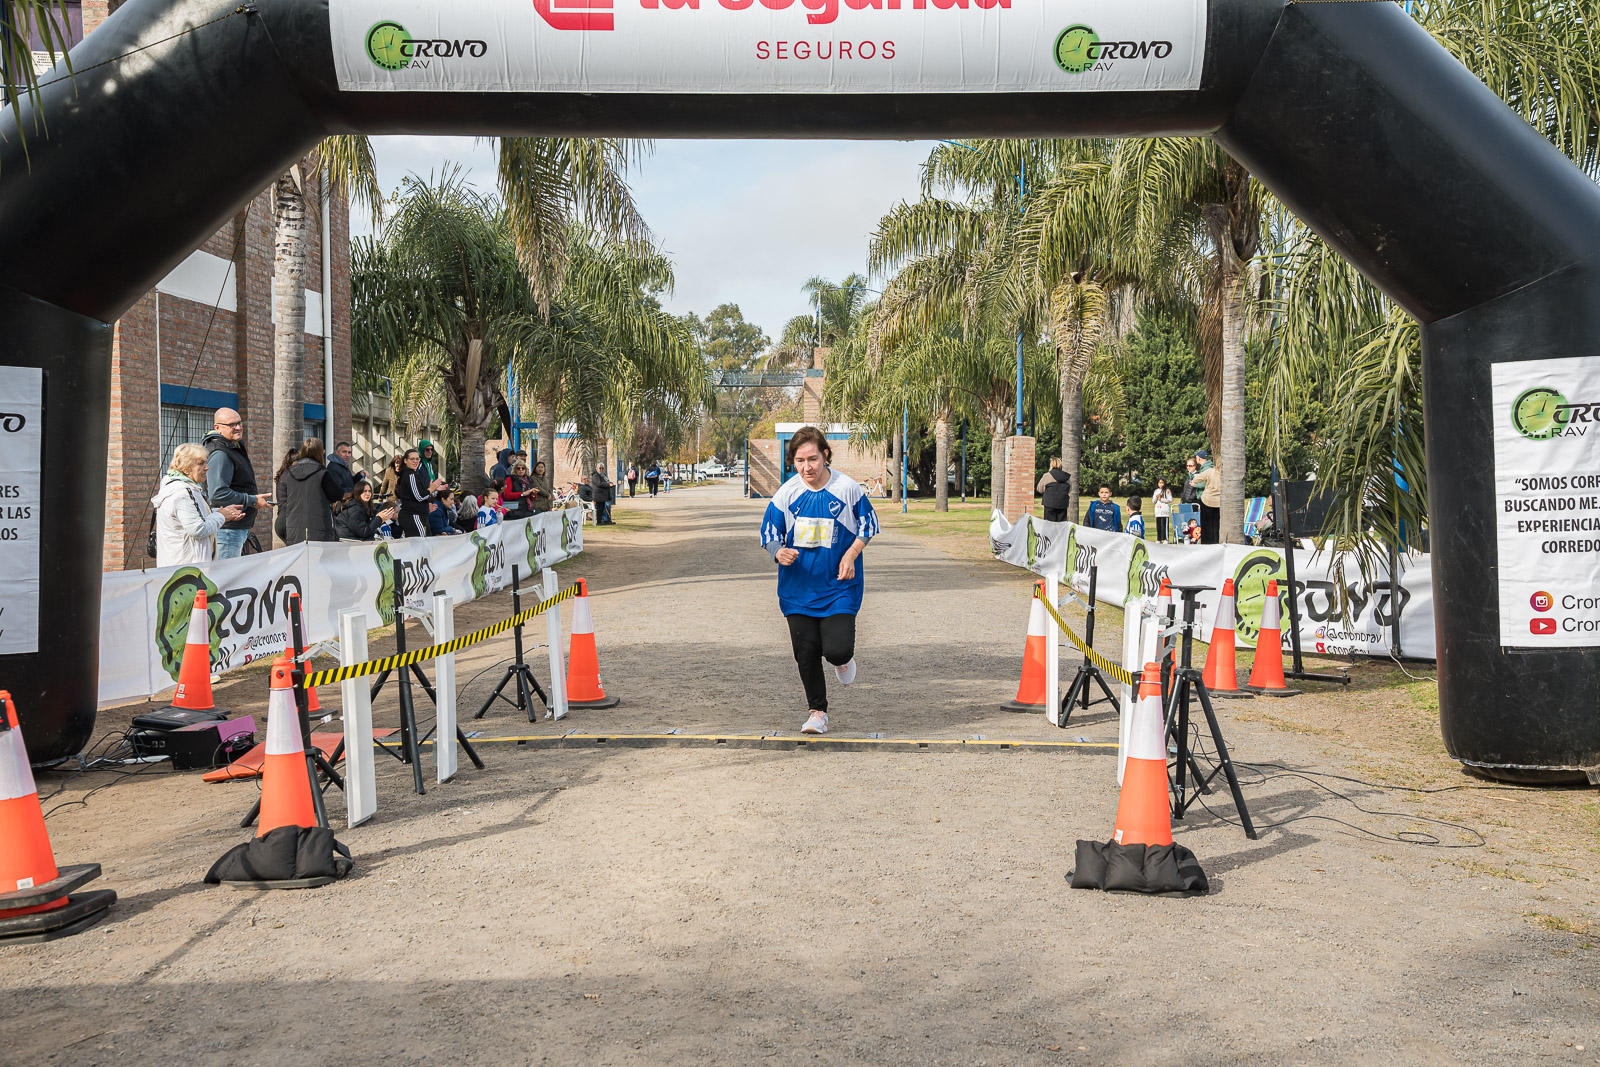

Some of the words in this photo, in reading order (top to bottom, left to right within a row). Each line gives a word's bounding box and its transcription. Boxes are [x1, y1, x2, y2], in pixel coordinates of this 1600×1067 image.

[400, 39, 488, 58] CRONO
[756, 40, 897, 60] SEGUROS
[1086, 40, 1173, 59] CRONO
[400, 59, 431, 69] RAV
[1083, 62, 1114, 72] RAV
[1551, 426, 1587, 437] RAV
[1504, 497, 1576, 512] BUSCANDO
[1579, 496, 1600, 510] ME
[7, 506, 31, 519] LAS
[798, 525, 829, 541] 735
[1517, 517, 1600, 533] EXPERIENCIA
